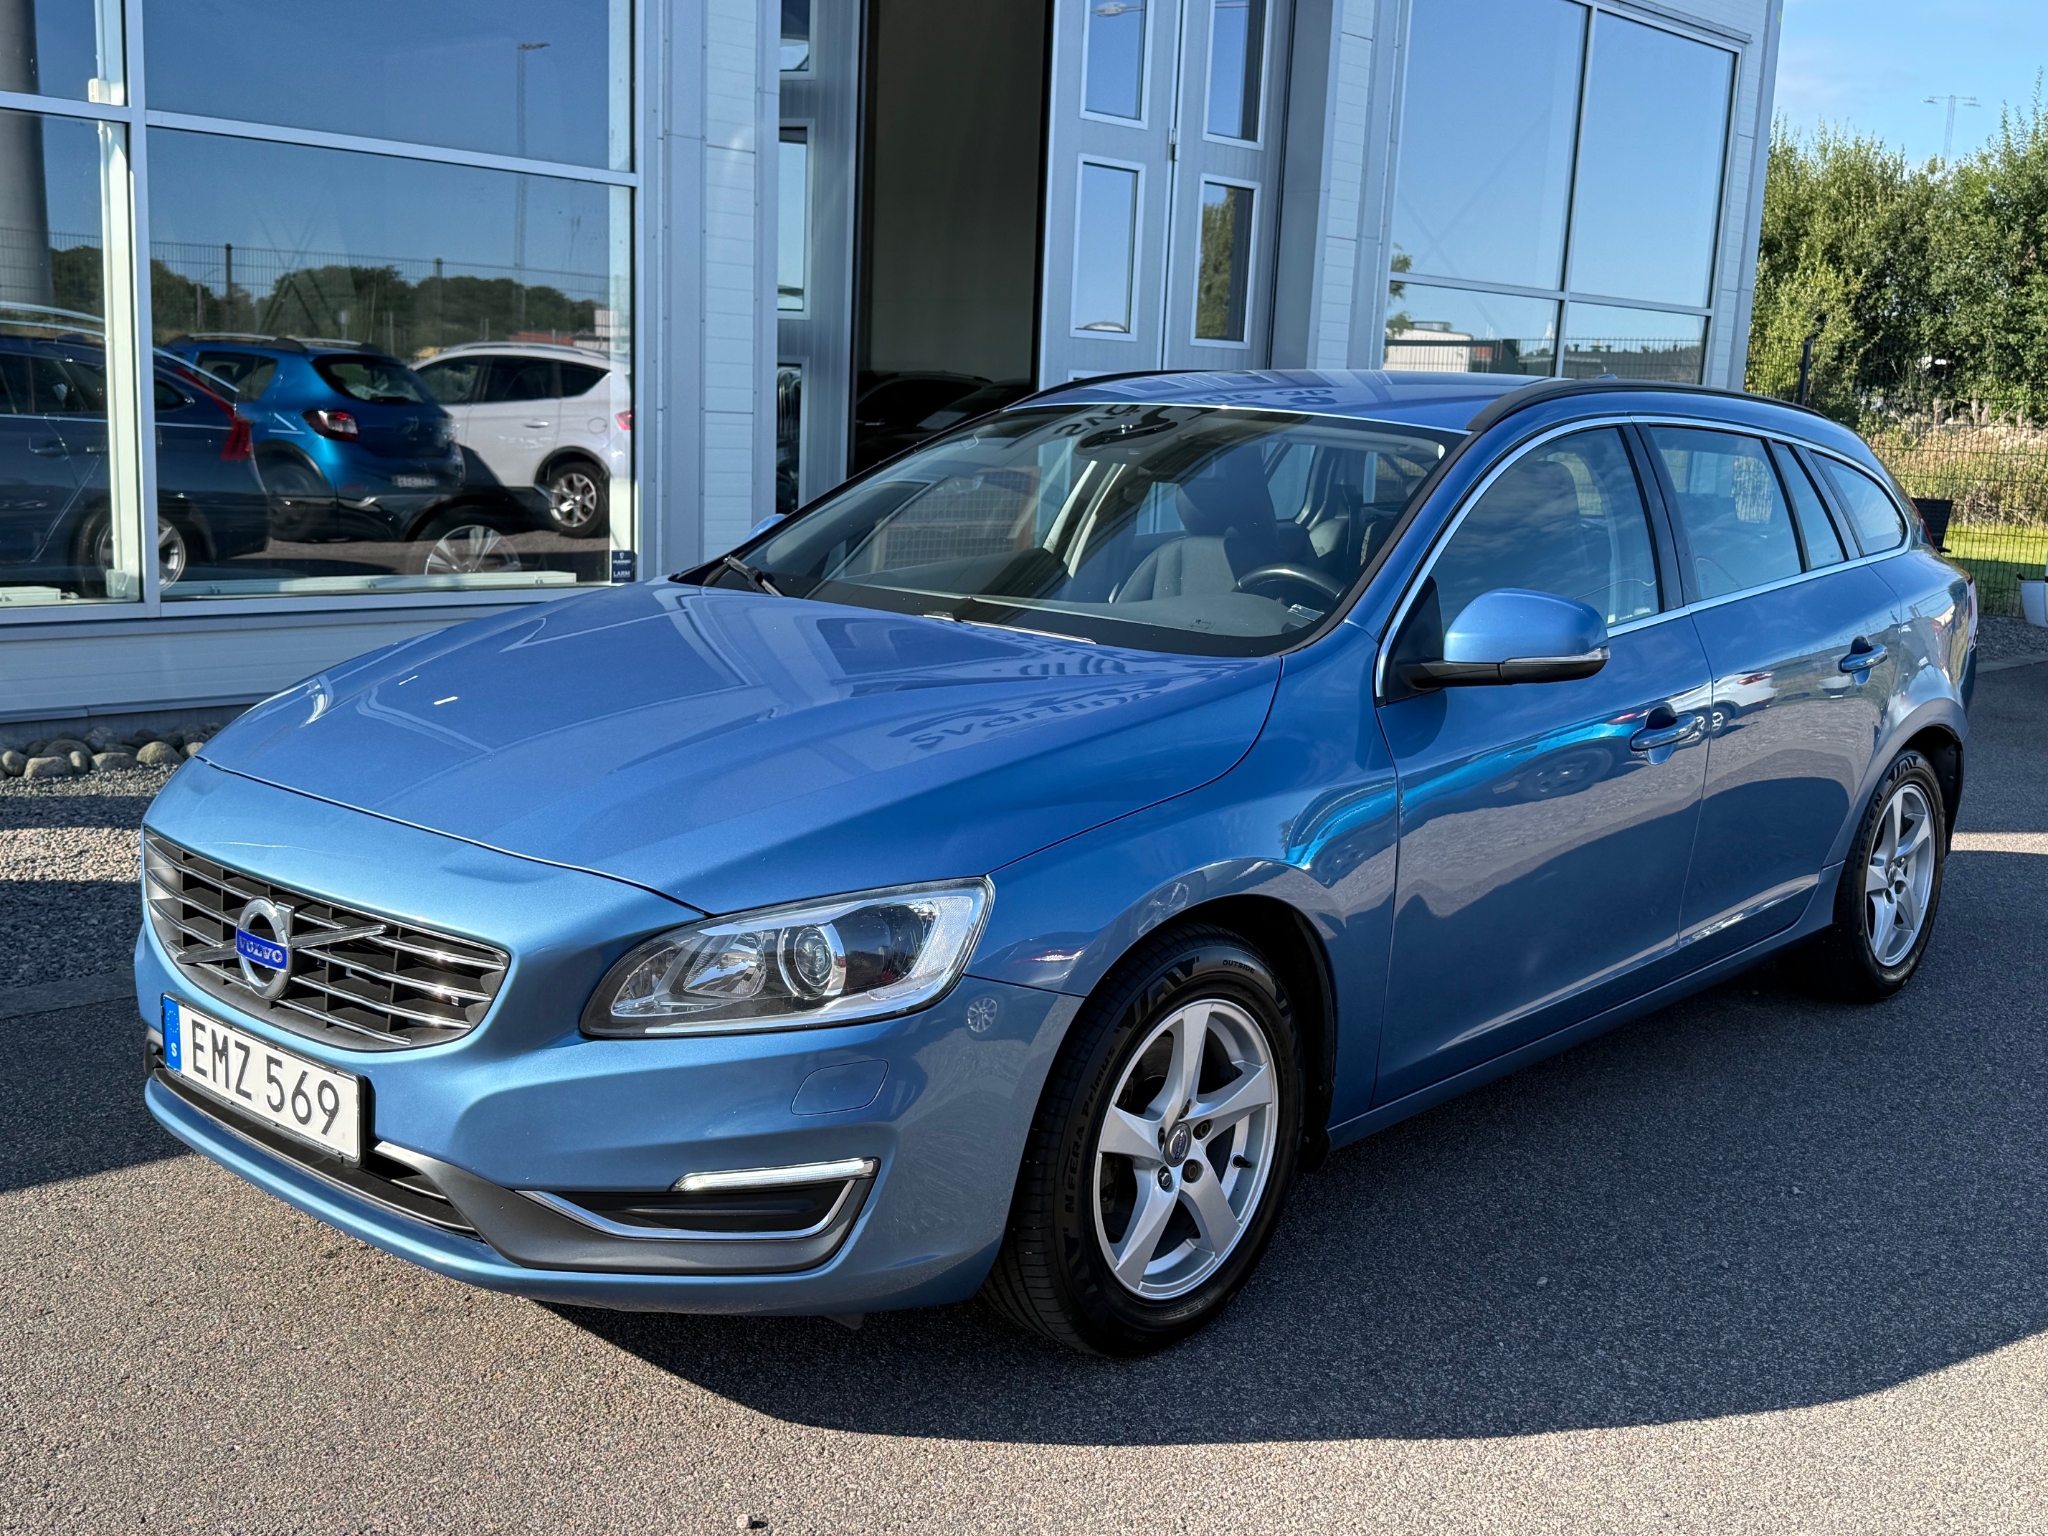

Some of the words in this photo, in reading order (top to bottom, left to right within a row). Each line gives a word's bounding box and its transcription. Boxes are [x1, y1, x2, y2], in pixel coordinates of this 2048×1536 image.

[1857, 792, 1883, 869] NEXEN
[239, 935, 283, 963] VOLVO
[1222, 959, 1256, 974] OUTSIDE
[171, 1042, 178, 1057] S
[191, 1018, 253, 1101] EMZ
[266, 1053, 340, 1136] 569
